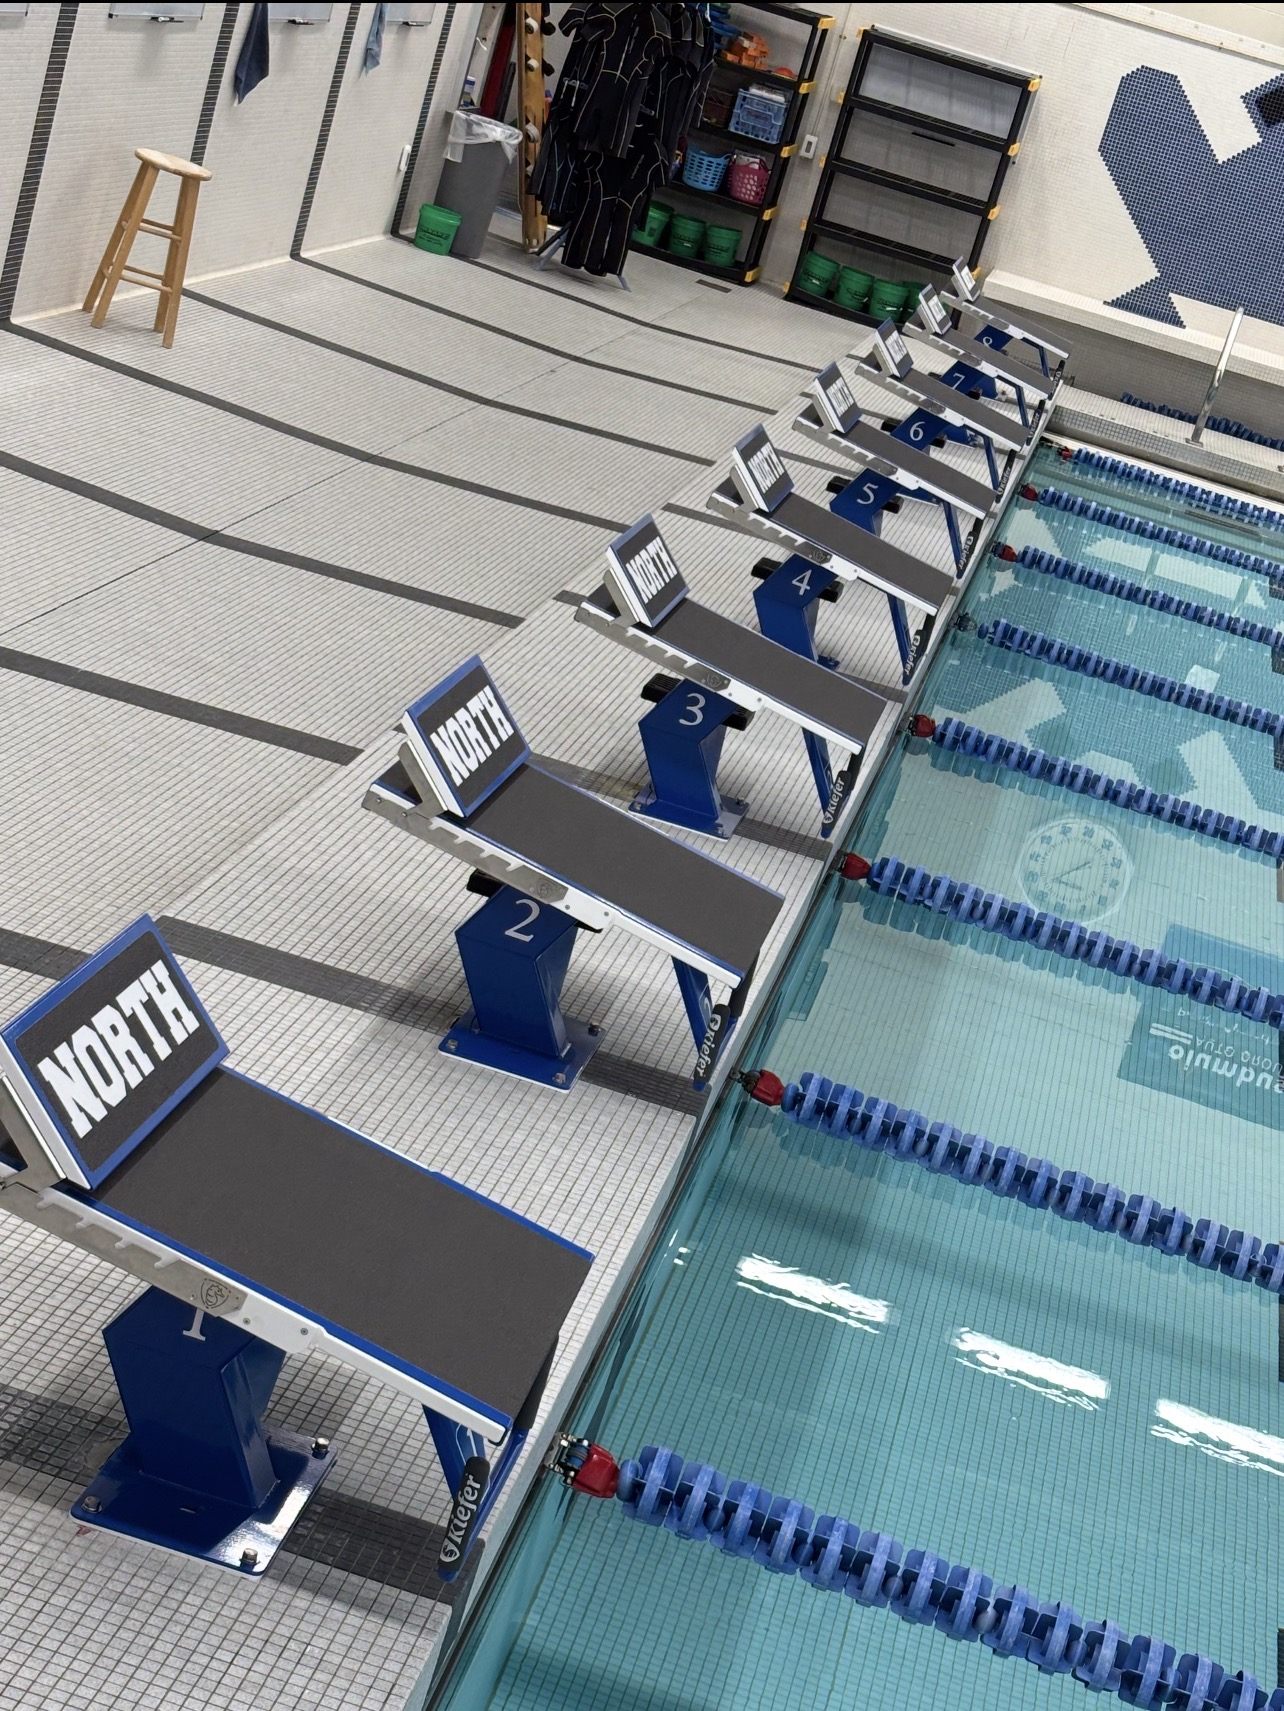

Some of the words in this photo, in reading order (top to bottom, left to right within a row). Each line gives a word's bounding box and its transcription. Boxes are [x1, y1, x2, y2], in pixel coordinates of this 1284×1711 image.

[952, 372, 966, 390] 7
[909, 420, 926, 442] 6
[747, 441, 785, 494] NORTH
[856, 483, 879, 506] 5
[625, 536, 678, 605] NORTH
[791, 569, 813, 596] 4
[904, 643, 922, 677] Kiefer
[678, 693, 706, 727] 3
[429, 685, 515, 787] NORTH
[827, 776, 845, 814] Kiefer
[504, 899, 541, 943] 2
[37, 959, 201, 1139] NORTH
[696, 1029, 717, 1078] Kiefer
[449, 1472, 482, 1545] Kiefer
